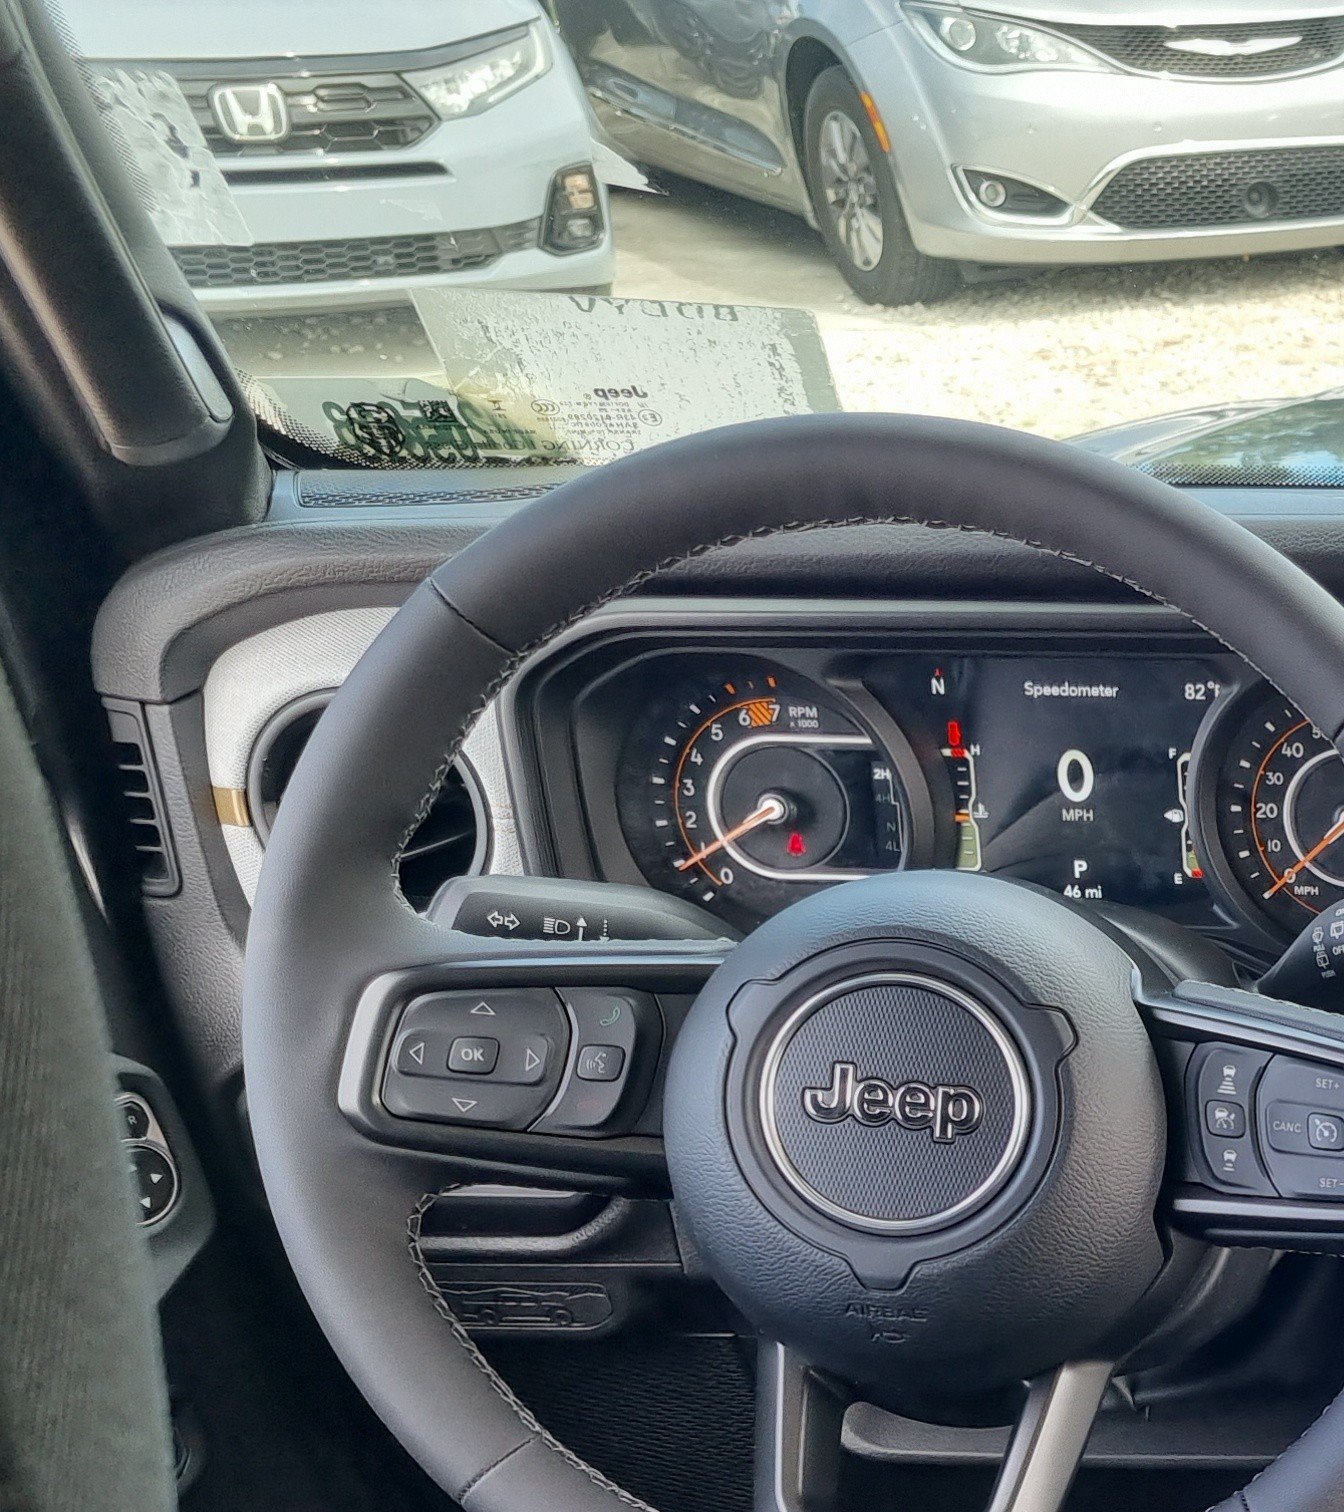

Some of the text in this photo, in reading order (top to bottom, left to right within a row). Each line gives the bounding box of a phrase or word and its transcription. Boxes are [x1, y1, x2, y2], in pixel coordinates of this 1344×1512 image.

[931, 677, 945, 695] N
[1024, 681, 1119, 699] Speedometer
[738, 708, 750, 726] 6
[770, 704, 781, 722] 7
[788, 705, 818, 719] RPM
[710, 724, 724, 742] 5
[690, 749, 703, 766] 4
[1281, 741, 1304, 759] 40
[874, 768, 890, 780] 2H
[1057, 749, 1094, 802] 0
[1265, 771, 1284, 787] 30
[682, 779, 695, 797] 3
[1061, 807, 1094, 823] MPH
[1256, 802, 1279, 819] 20
[685, 811, 698, 829] 2
[1266, 839, 1282, 854] 10
[720, 867, 733, 885] 0
[1073, 860, 1088, 879] P
[1173, 872, 1183, 885] E
[1063, 885, 1102, 899] 46 mi
[1294, 886, 1319, 897] MPH
[461, 1049, 485, 1062] OK
[803, 1061, 985, 1145] Jeep
[1272, 1121, 1302, 1133] CANC
